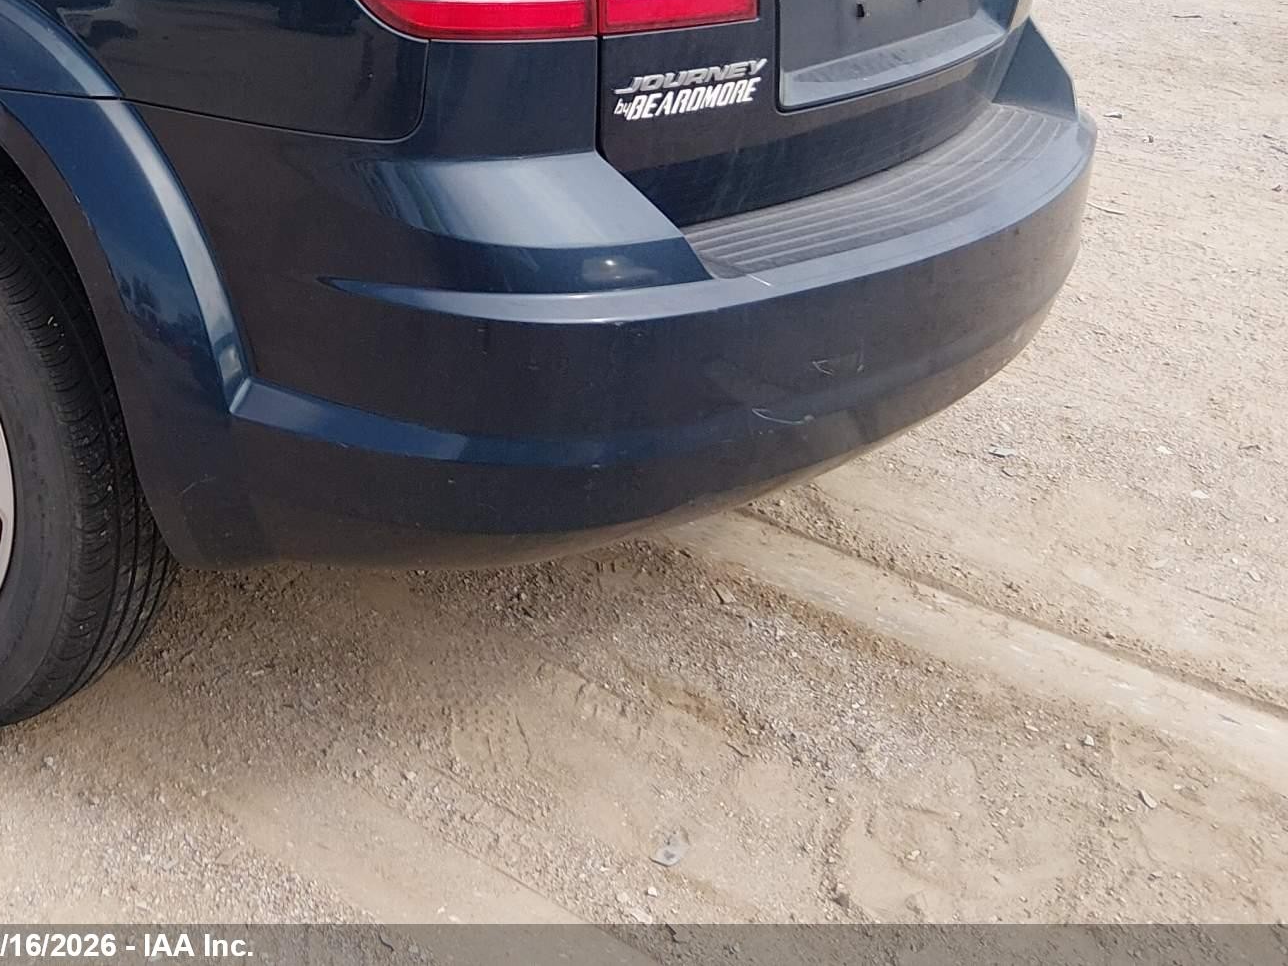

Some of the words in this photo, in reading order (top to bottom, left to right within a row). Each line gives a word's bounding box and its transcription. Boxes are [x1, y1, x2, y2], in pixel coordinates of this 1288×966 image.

[613, 58, 768, 95] JOURNEY
[614, 98, 632, 117] by
[626, 77, 761, 121] BEARDMORE
